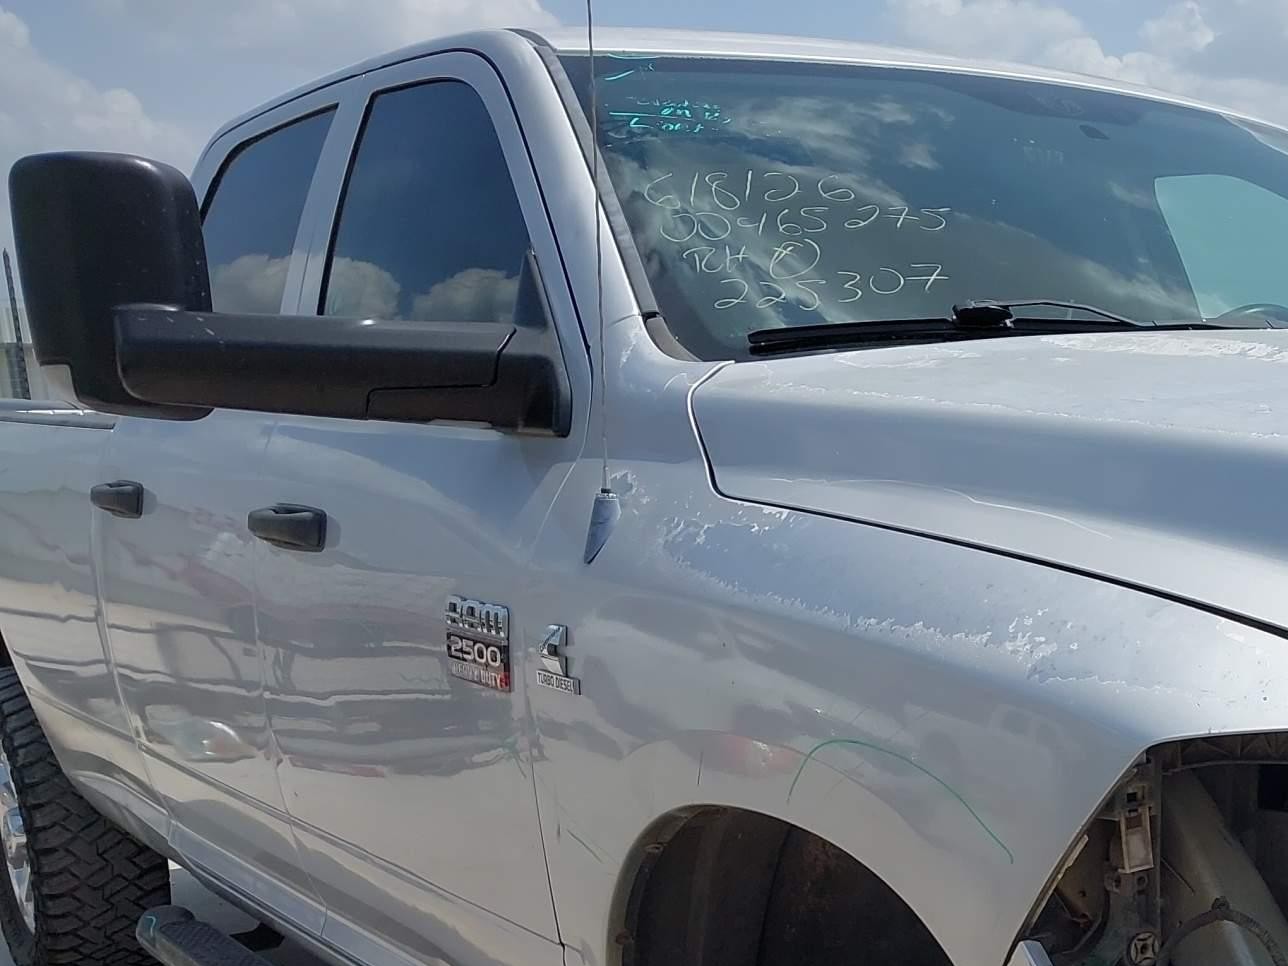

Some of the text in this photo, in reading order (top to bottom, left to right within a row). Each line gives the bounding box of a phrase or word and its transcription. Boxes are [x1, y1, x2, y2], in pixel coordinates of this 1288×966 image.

[446, 595, 508, 637] RAM
[450, 635, 501, 667] 2500
[480, 670, 502, 689] DUTY
[537, 671, 574, 692] TURBO DIESEL
